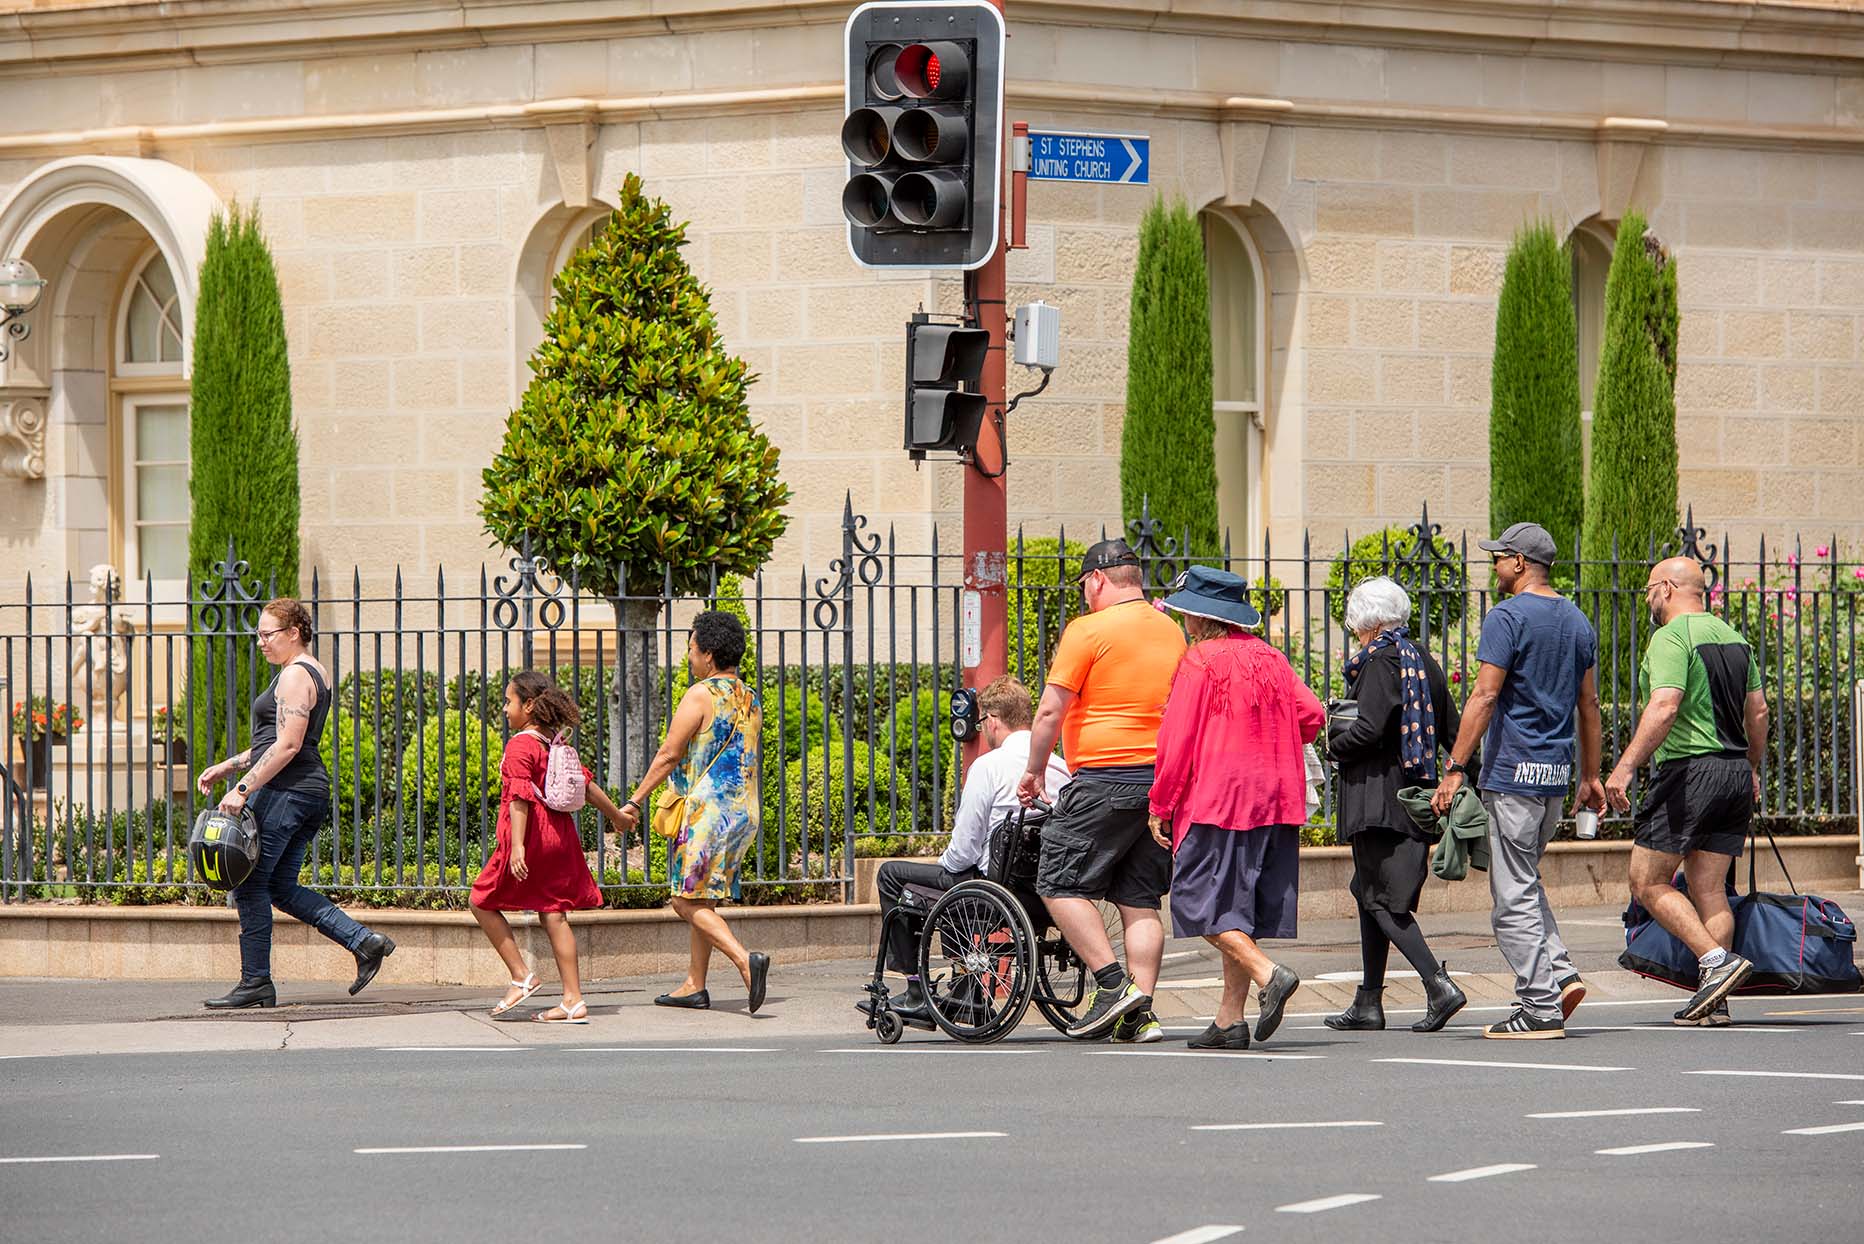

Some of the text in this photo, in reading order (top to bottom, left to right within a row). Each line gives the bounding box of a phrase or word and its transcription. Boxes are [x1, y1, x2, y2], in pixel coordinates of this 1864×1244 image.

[1040, 137, 1105, 158] ST STEPHENS
[1034, 158, 1111, 179] UNITING CHURCH
